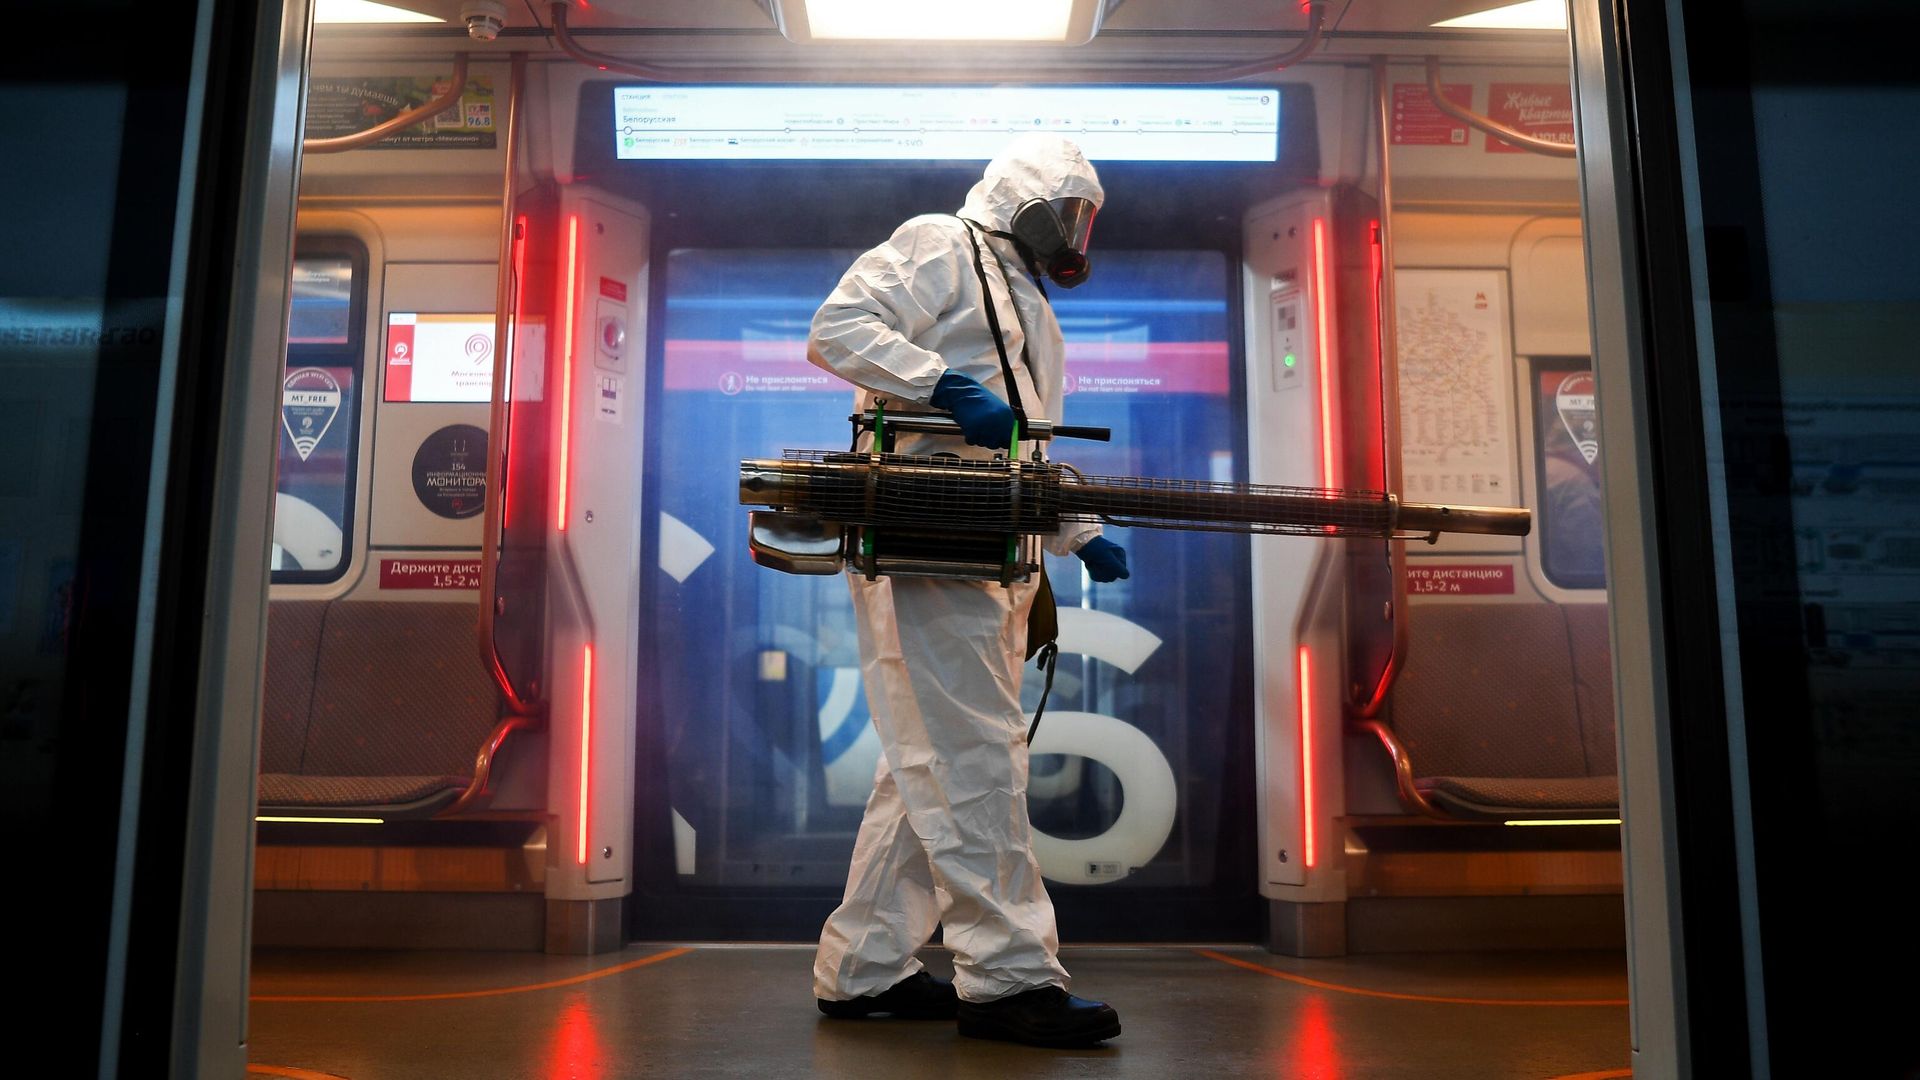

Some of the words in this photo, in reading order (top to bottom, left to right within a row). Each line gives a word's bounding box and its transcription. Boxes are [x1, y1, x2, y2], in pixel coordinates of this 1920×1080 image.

[467, 117, 491, 127] 96.8
[622, 114, 677, 125] Белорусская
[761, 376, 829, 386] прислоняться
[1078, 375, 1092, 385] Не
[1094, 377, 1161, 387] прислоняться
[452, 463, 466, 471] 154
[426, 477, 487, 487] МОНИТОРА
[390, 561, 450, 575] Держите
[452, 564, 482, 575] дист
[1432, 569, 1503, 581] дистанцию
[433, 575, 466, 588] 1,5-2
[468, 578, 480, 587] м
[1414, 580, 1447, 593] 1,5-2
[1449, 583, 1462, 592] м
